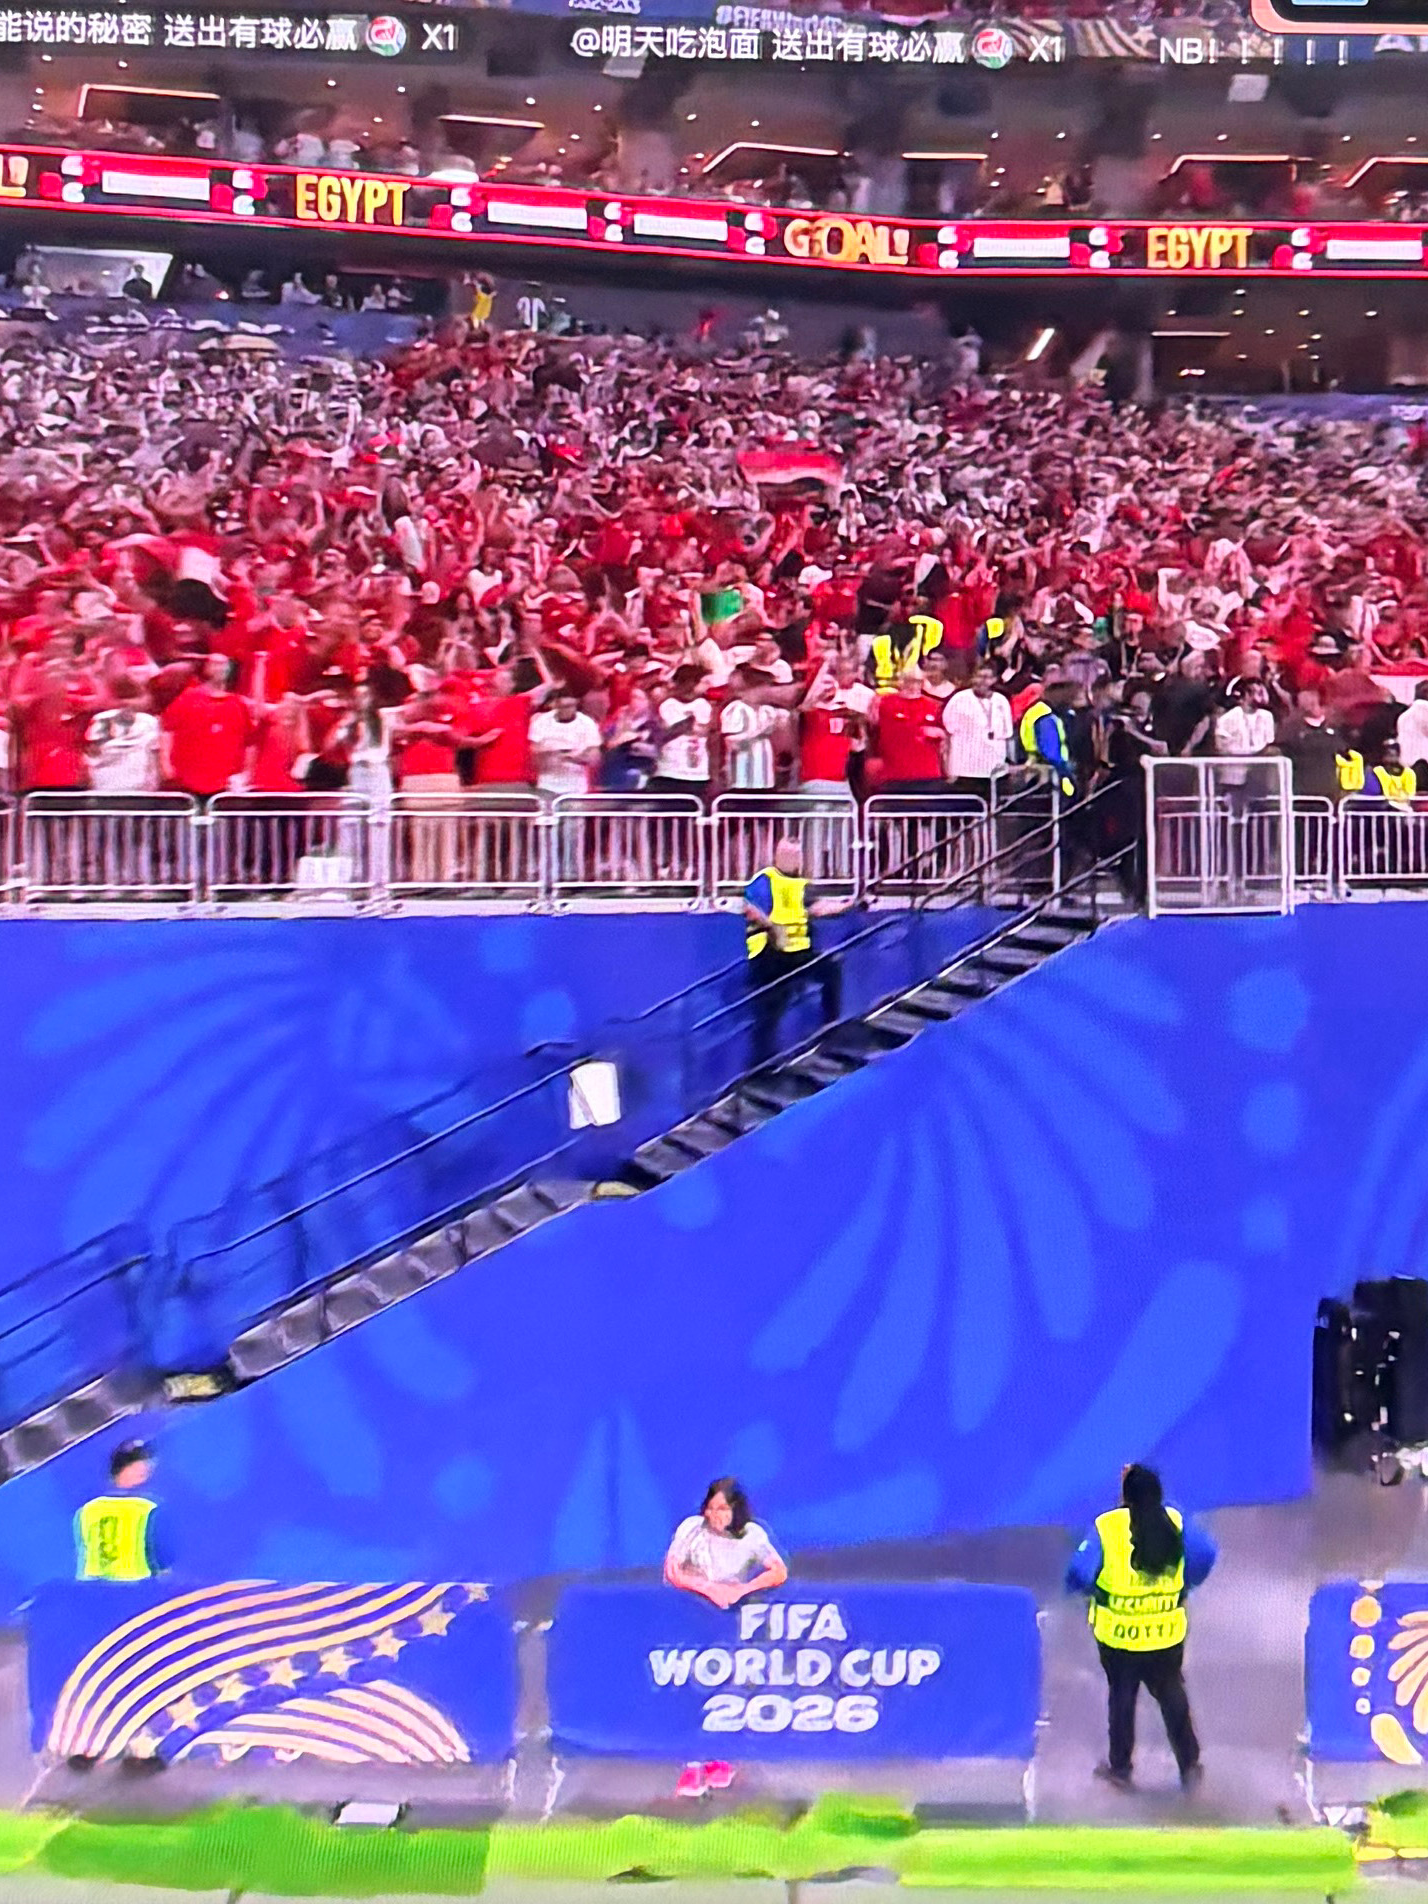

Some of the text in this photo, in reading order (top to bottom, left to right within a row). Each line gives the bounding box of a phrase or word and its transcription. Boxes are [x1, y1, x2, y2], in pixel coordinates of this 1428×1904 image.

[164, 14, 359, 51] 送出有球必赢
[421, 23, 458, 52] X1
[572, 26, 1063, 65] @明天吃泡面 送出有球必赢 X1
[295, 174, 412, 227] EGYPT
[1146, 227, 1253, 269] EGYPT
[739, 1603, 848, 1641] FIFA
[649, 1647, 941, 1688] WORLD CUP
[701, 1693, 880, 1733] 2026
